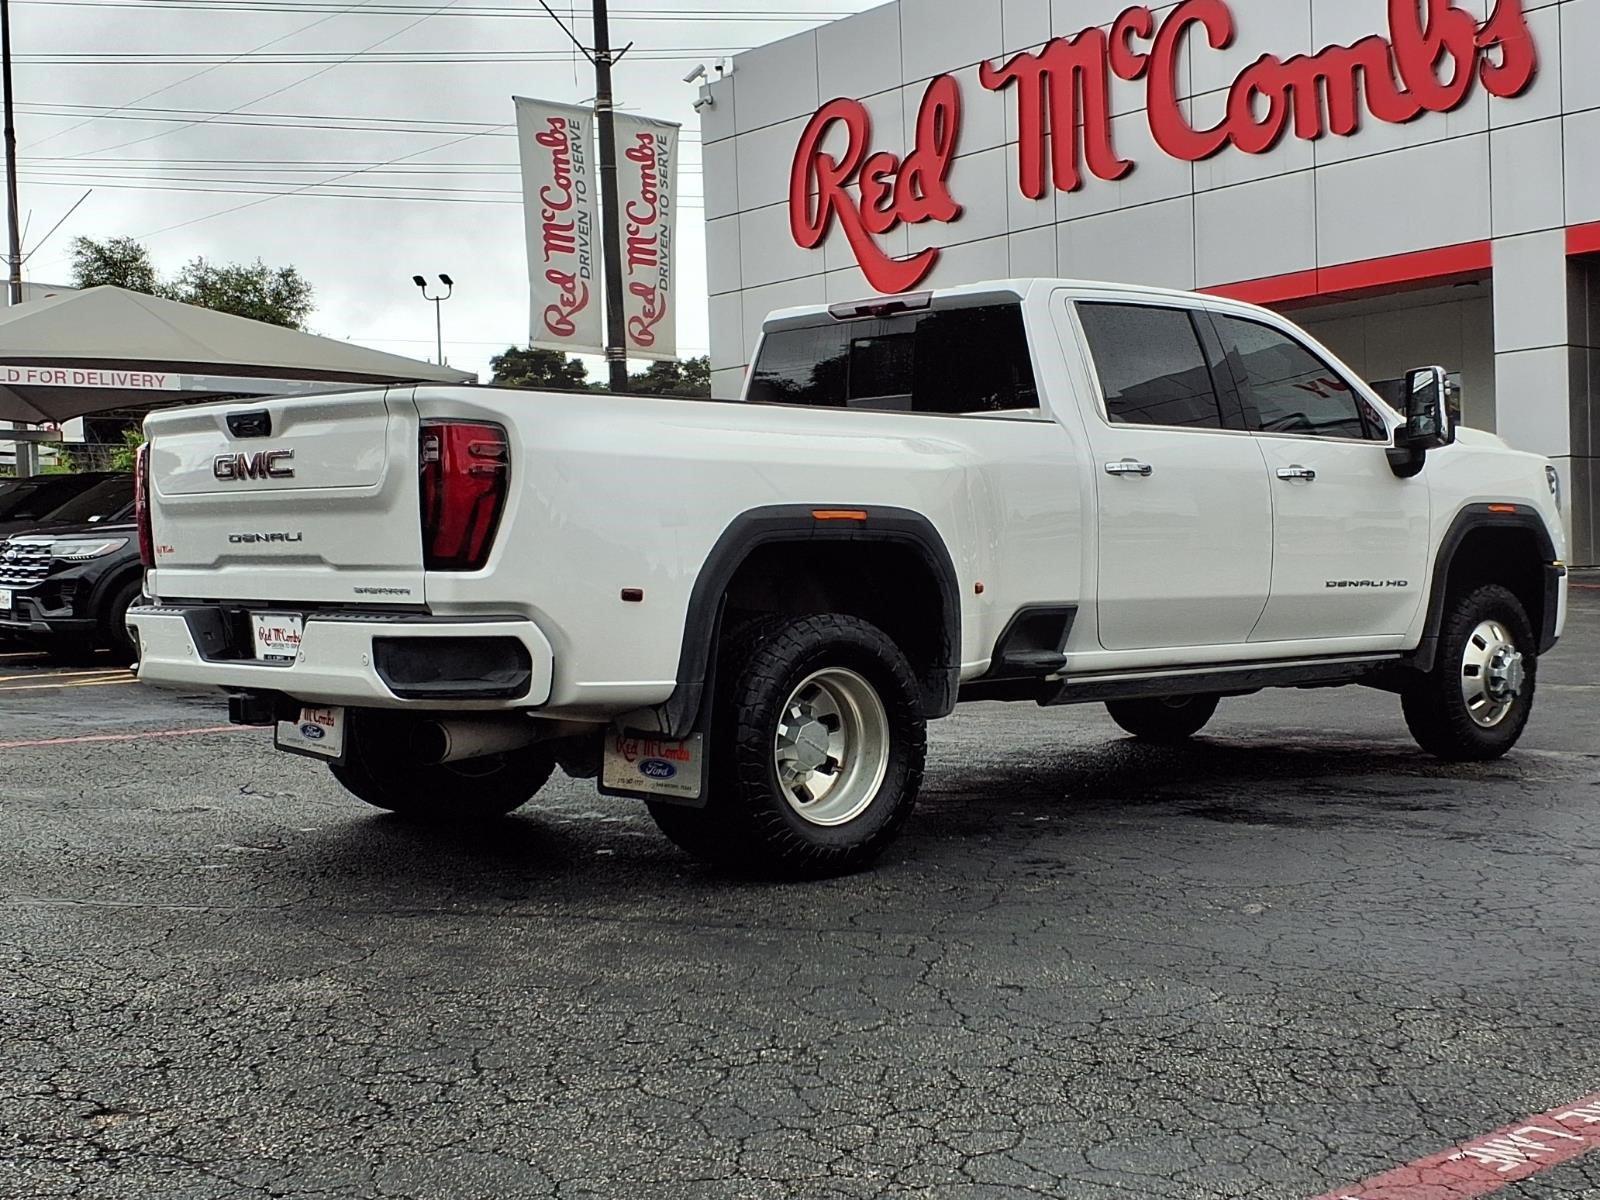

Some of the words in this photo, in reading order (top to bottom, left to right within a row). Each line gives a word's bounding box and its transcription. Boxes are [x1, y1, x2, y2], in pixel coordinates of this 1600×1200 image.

[568, 118, 586, 174] SERVE
[655, 134, 669, 190] SERVE
[789, 73, 963, 294] Red
[980, 0, 1537, 201] McCombs
[535, 117, 576, 262] McCombs
[575, 180, 588, 203] TO
[625, 132, 658, 275] McCombs
[659, 195, 670, 218] TO
[575, 210, 592, 281] DRIVEN
[658, 224, 669, 292] DRIVEN
[544, 269, 589, 337] Red
[628, 281, 667, 347] Red
[27, 370, 67, 384] FOR
[73, 371, 166, 388] DELIVERY
[213, 448, 295, 481] GMC
[228, 531, 303, 544] DENALI
[1325, 580, 1383, 588] DENALI
